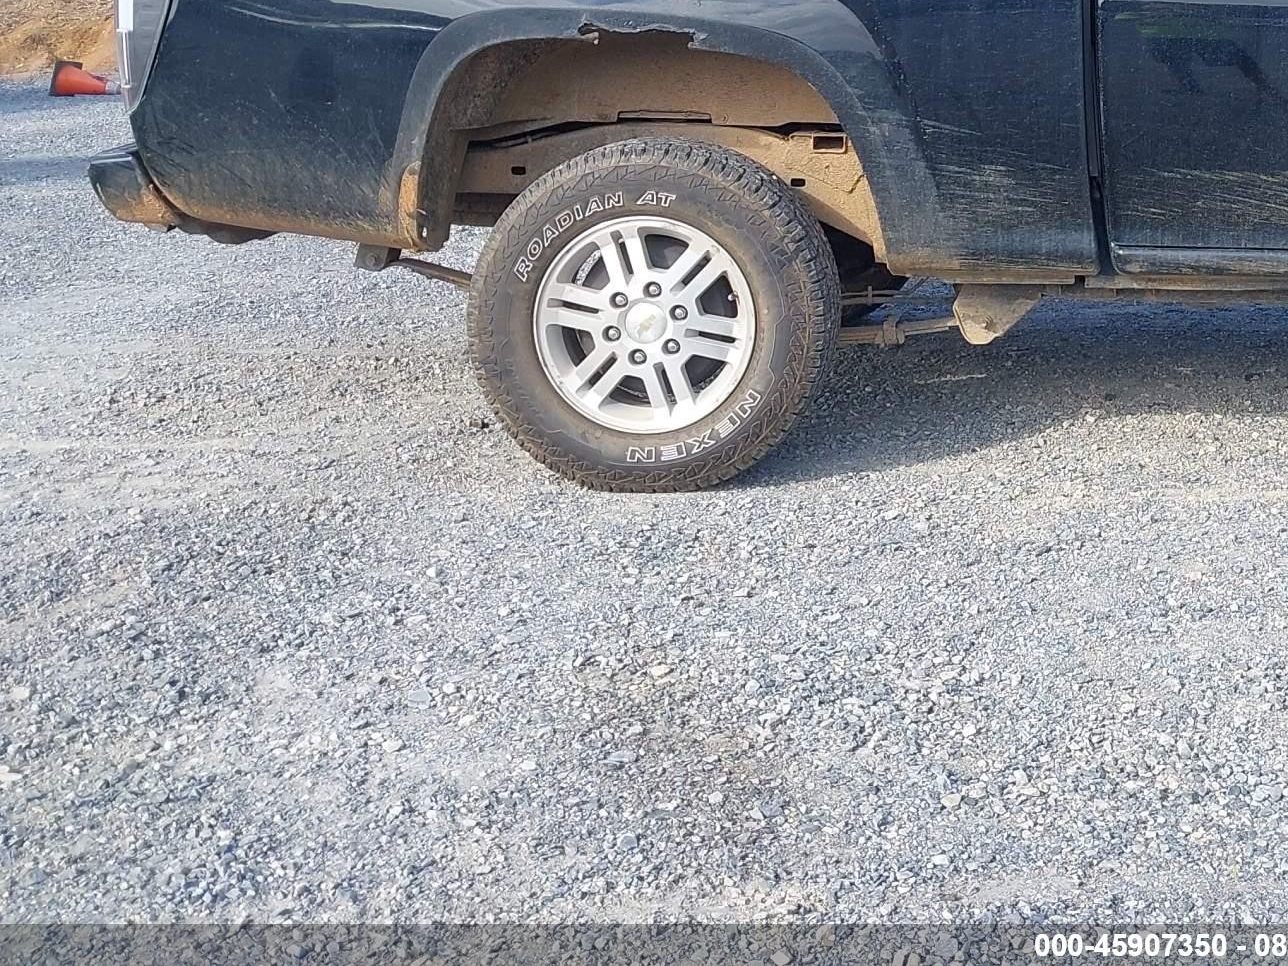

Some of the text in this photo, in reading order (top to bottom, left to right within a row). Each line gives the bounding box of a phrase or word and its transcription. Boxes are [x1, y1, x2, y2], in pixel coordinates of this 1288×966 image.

[513, 190, 677, 282] ROADIAN AT
[625, 389, 762, 463] NEXEN
